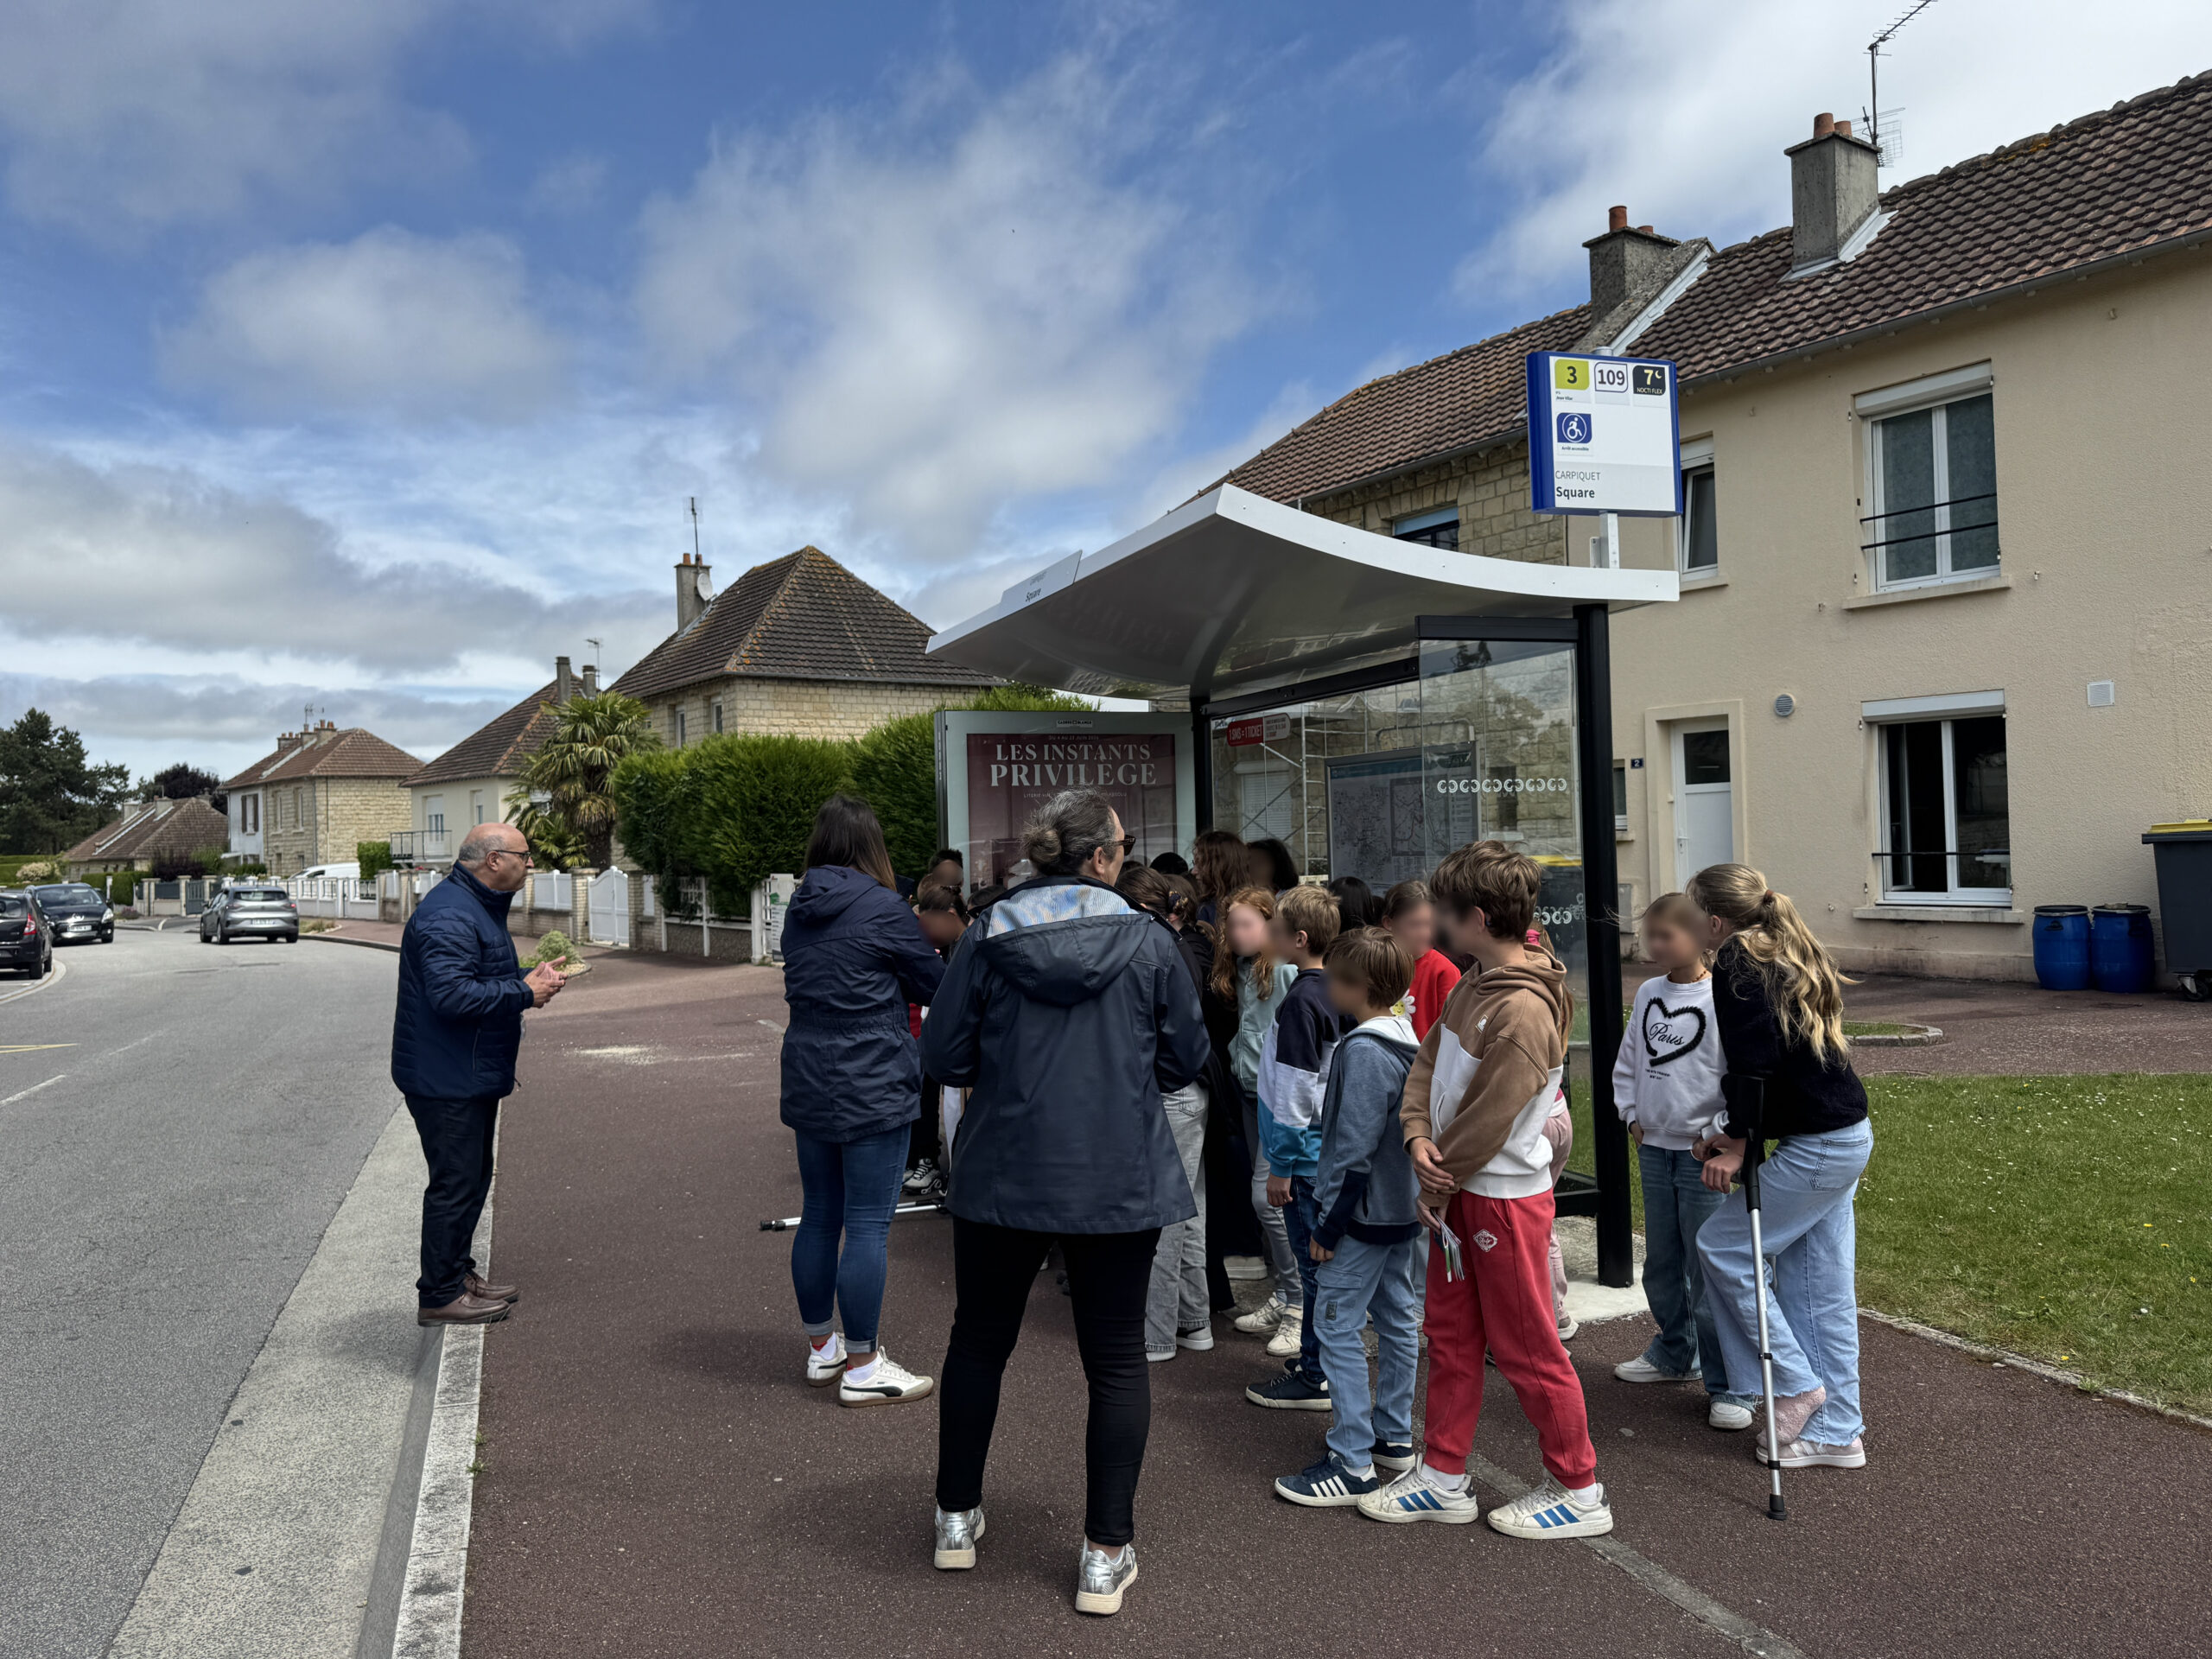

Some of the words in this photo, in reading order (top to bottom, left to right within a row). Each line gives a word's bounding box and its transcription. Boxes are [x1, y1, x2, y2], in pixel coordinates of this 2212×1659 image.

[1567, 365, 1578, 384] 3
[1598, 369, 1625, 386] 109
[1643, 369, 1653, 385] 7
[1555, 470, 1601, 481] CARPIQUET
[1555, 486, 1595, 499] Square
[1248, 724, 1262, 738] TICKET
[996, 744, 1037, 761] LES
[1043, 744, 1151, 761] INSTANTS
[1649, 1022, 1685, 1046] Paris
